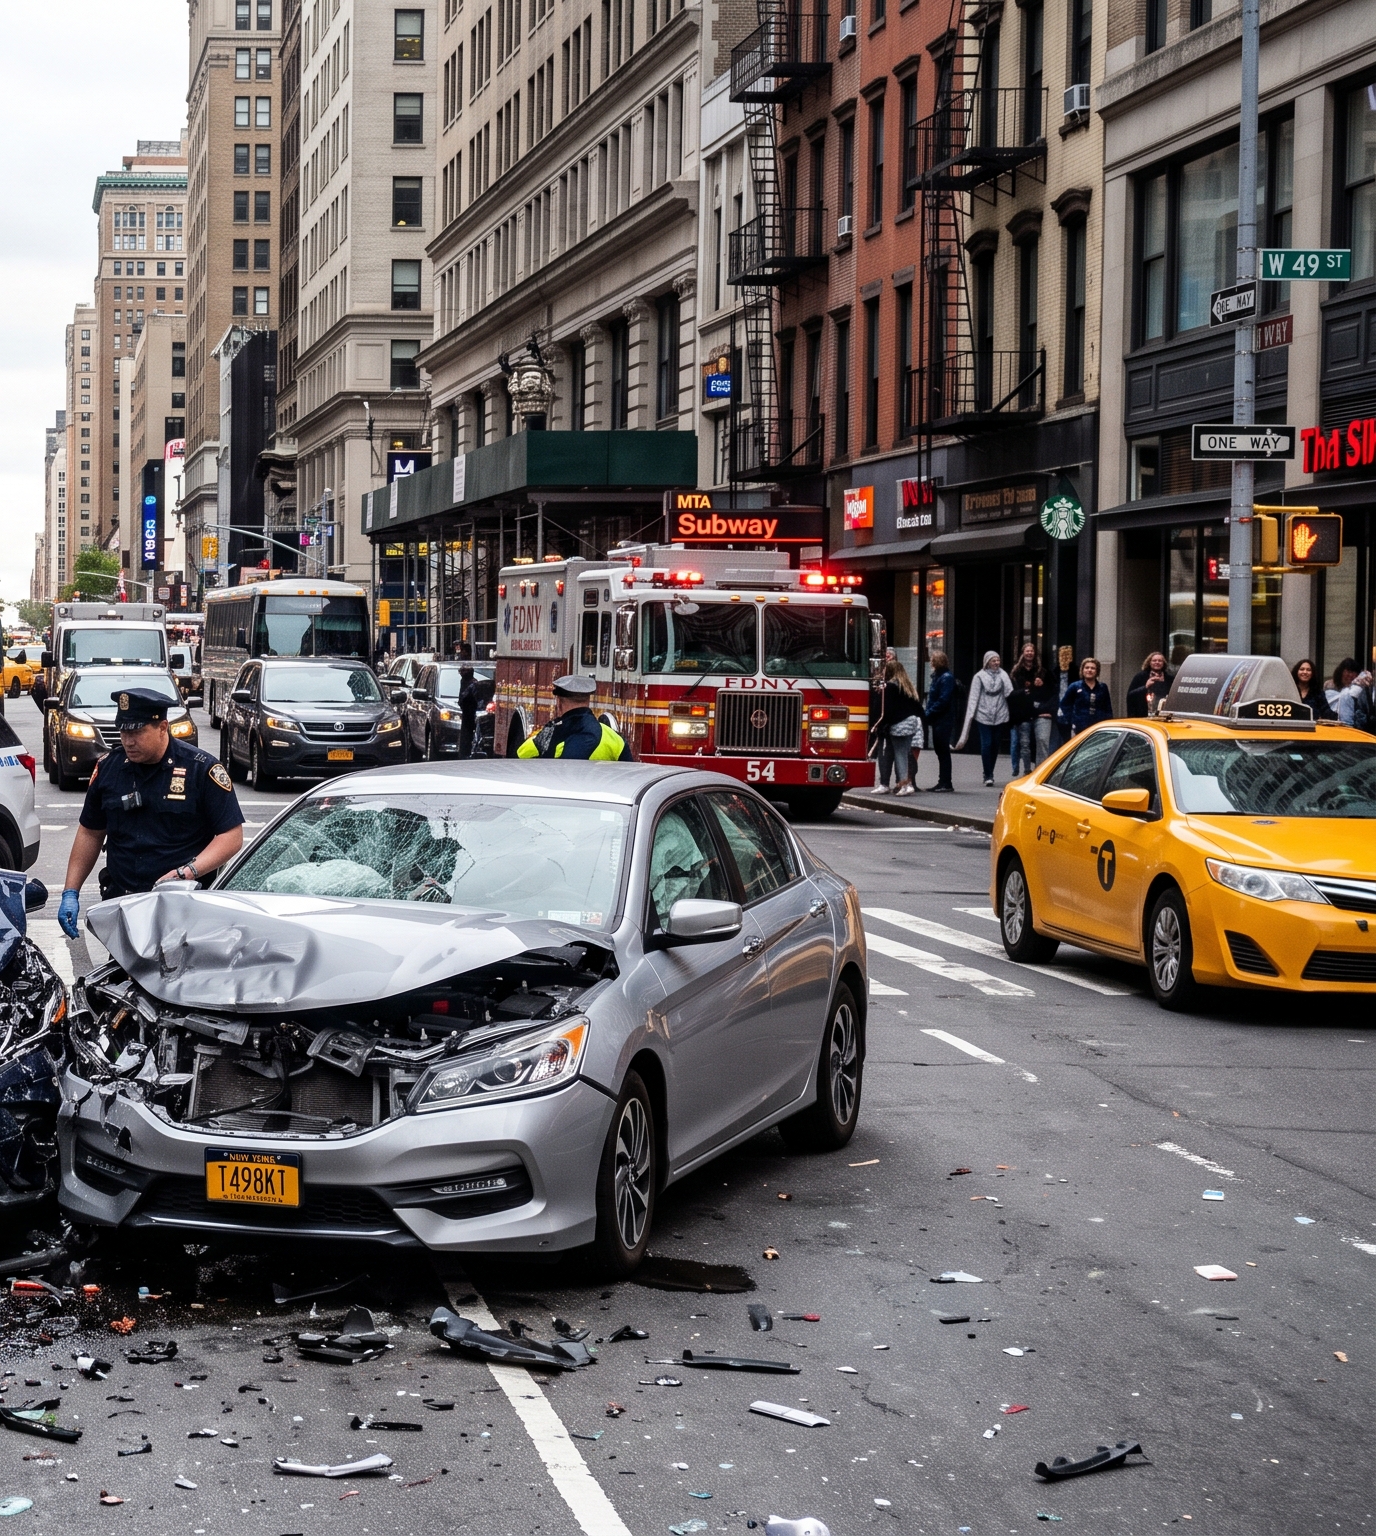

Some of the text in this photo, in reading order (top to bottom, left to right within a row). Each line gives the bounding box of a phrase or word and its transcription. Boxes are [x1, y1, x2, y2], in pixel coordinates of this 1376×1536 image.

[1268, 253, 1343, 276] W 49 ST
[1208, 436, 1281, 450] ONE WAY
[677, 495, 711, 509] MTA
[678, 513, 778, 539] Subway
[512, 605, 542, 634] FDNY
[725, 677, 799, 690] FDNY
[746, 760, 775, 782] 54
[218, 1165, 285, 1196] T498KT
